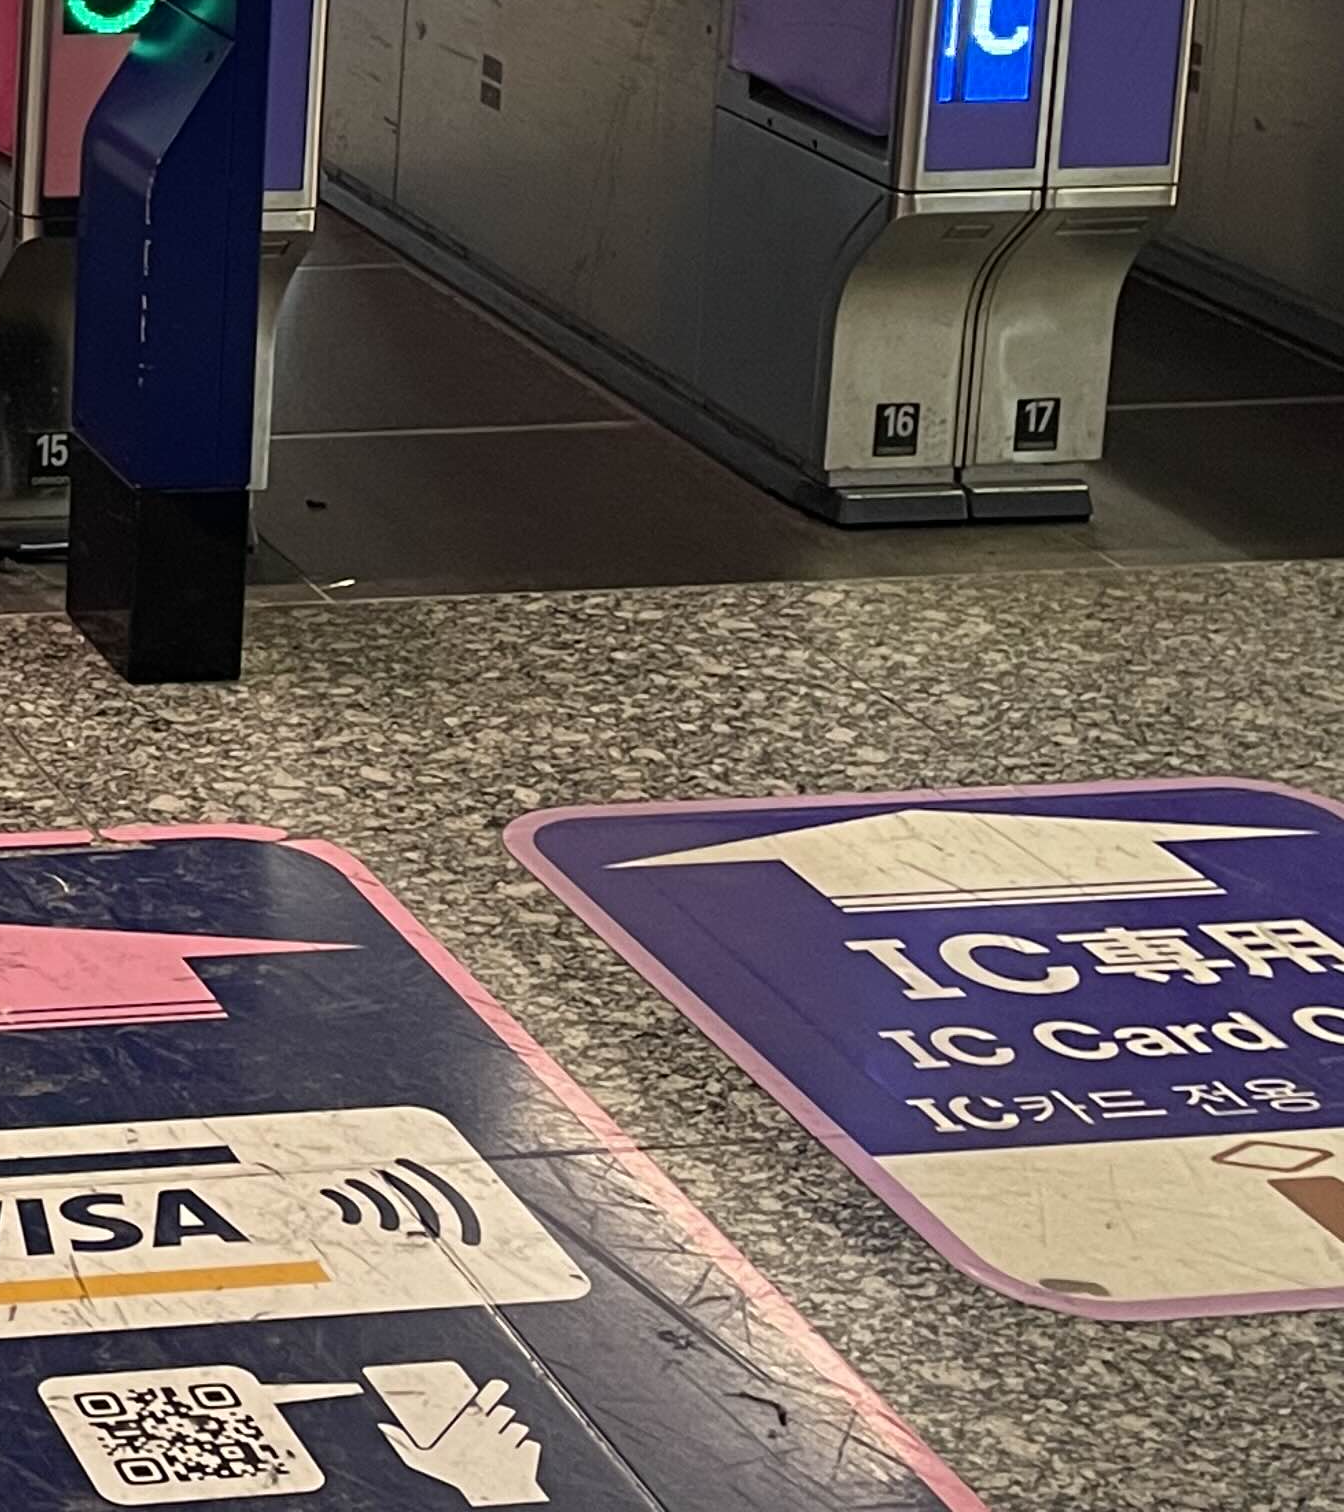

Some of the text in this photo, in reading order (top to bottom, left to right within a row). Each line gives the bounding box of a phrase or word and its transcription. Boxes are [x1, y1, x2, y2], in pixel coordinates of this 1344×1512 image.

[883, 405, 915, 438] 16
[1024, 401, 1056, 433] 17
[36, 433, 68, 467] 15
[844, 919, 1344, 1001] IC専用
[878, 1027, 1016, 1070] IC
[1032, 1011, 1289, 1061] Card
[905, 1077, 1322, 1133] IC카드 전용
